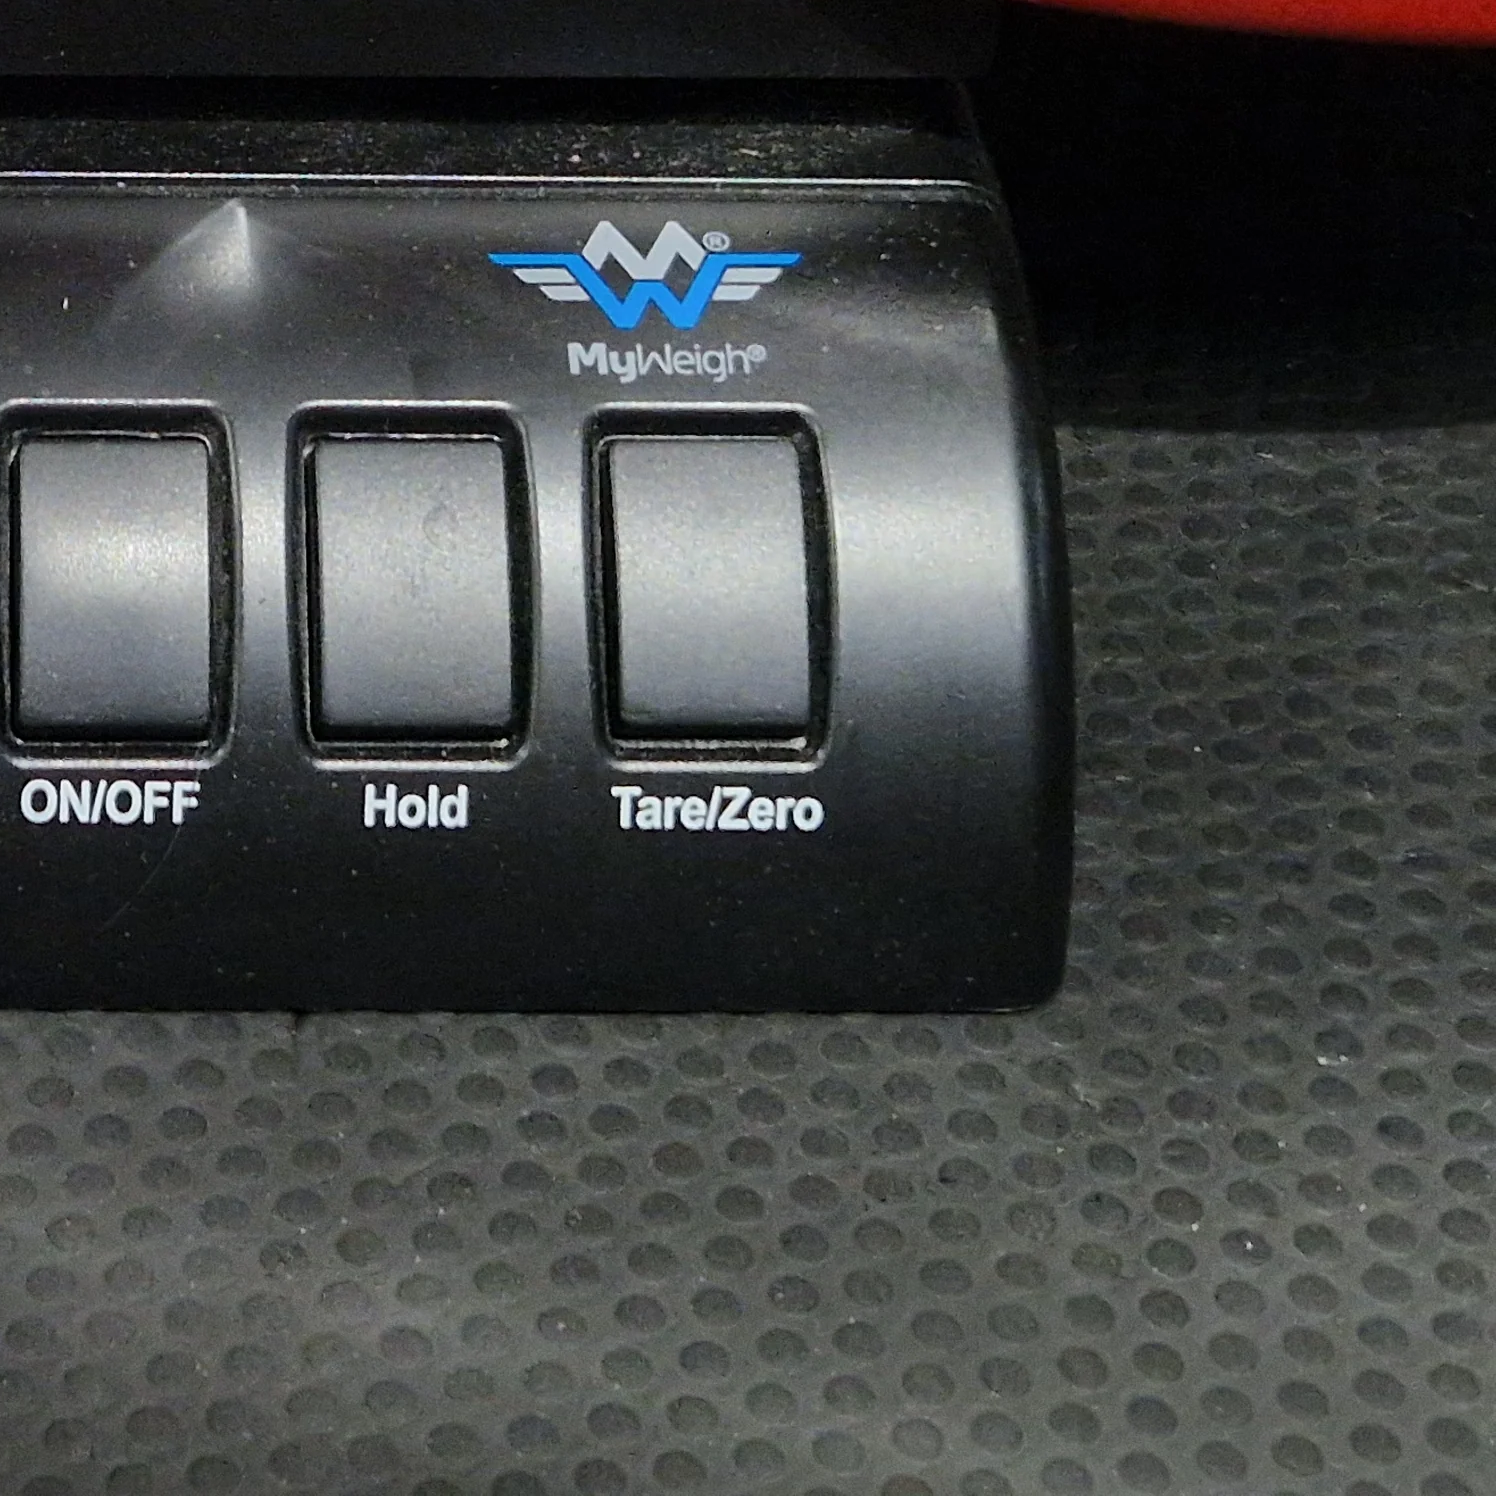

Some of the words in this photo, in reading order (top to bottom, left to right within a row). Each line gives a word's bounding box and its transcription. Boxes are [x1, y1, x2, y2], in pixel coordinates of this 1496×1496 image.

[19, 778, 202, 825] ON/OFF
[362, 783, 470, 829] Hold
[609, 784, 825, 832] Tare/Zero
